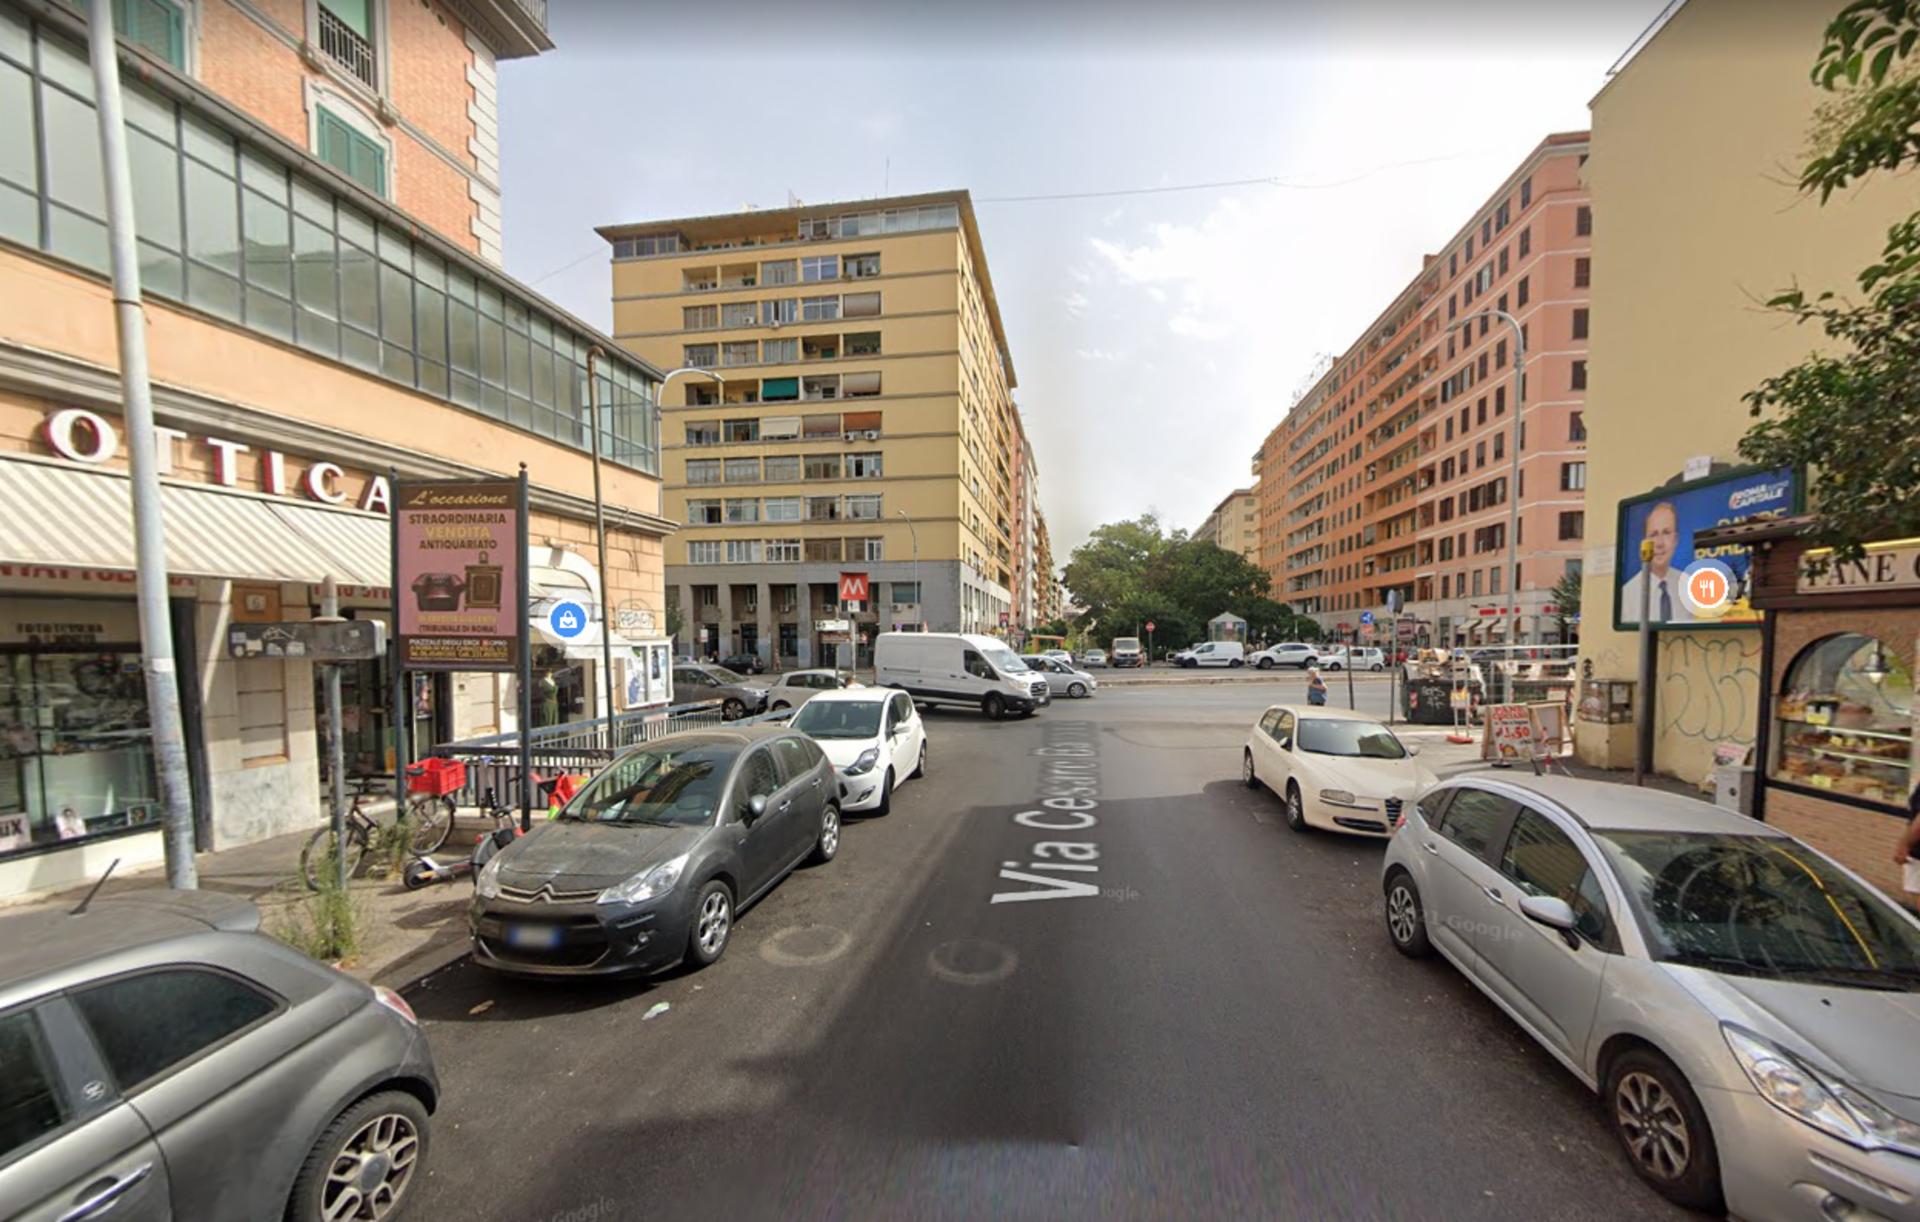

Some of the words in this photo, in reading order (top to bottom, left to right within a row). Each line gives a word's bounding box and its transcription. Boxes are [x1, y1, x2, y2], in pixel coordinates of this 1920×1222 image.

[46, 408, 390, 512] OTTICA
[409, 513, 506, 524] STRAORDINARIA
[425, 527, 491, 538] VENDITA
[419, 540, 497, 549] ANTIQUARIATO
[842, 578, 865, 596] M
